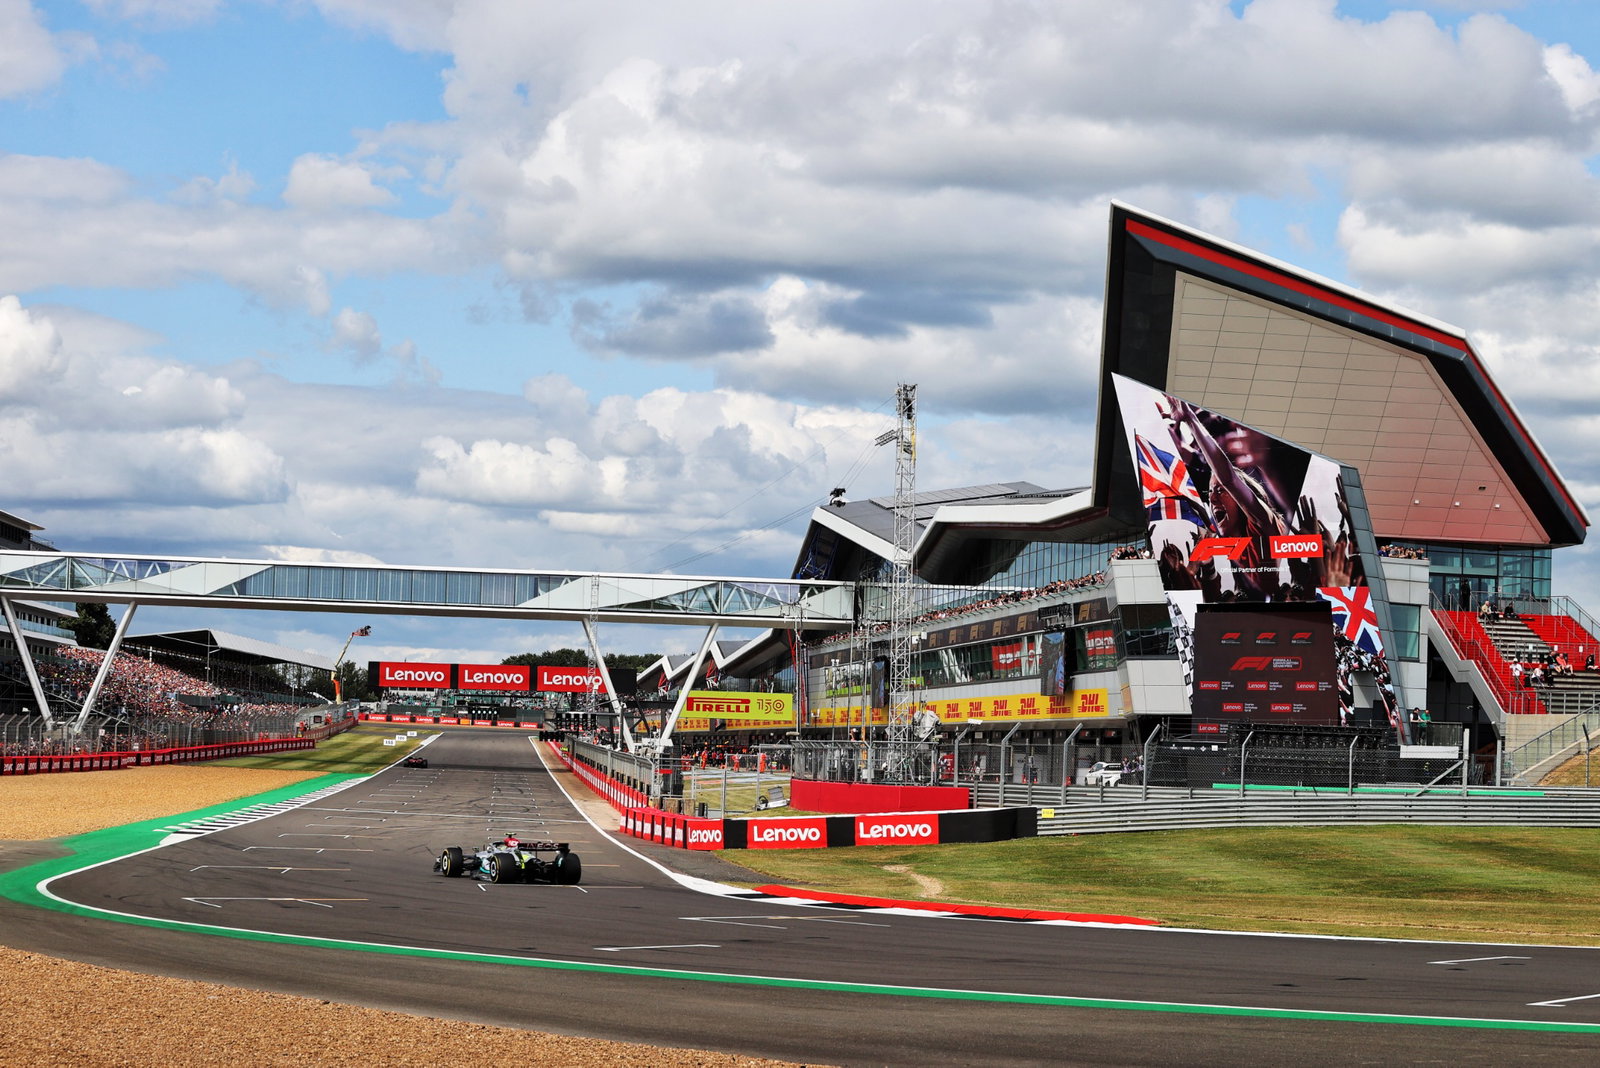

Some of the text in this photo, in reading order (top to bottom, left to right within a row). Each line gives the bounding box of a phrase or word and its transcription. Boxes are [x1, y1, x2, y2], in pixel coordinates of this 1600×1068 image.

[1274, 540, 1318, 553] Lenovo
[385, 667, 445, 682] Lenovo
[464, 670, 524, 684] Lenovo
[543, 672, 603, 686] Lenovo
[686, 697, 784, 714] PIRELLI 150
[1077, 693, 1104, 713] DHL
[688, 827, 722, 843] Lenovo
[753, 826, 820, 842] Lenovo
[859, 821, 932, 839] Lenovo
